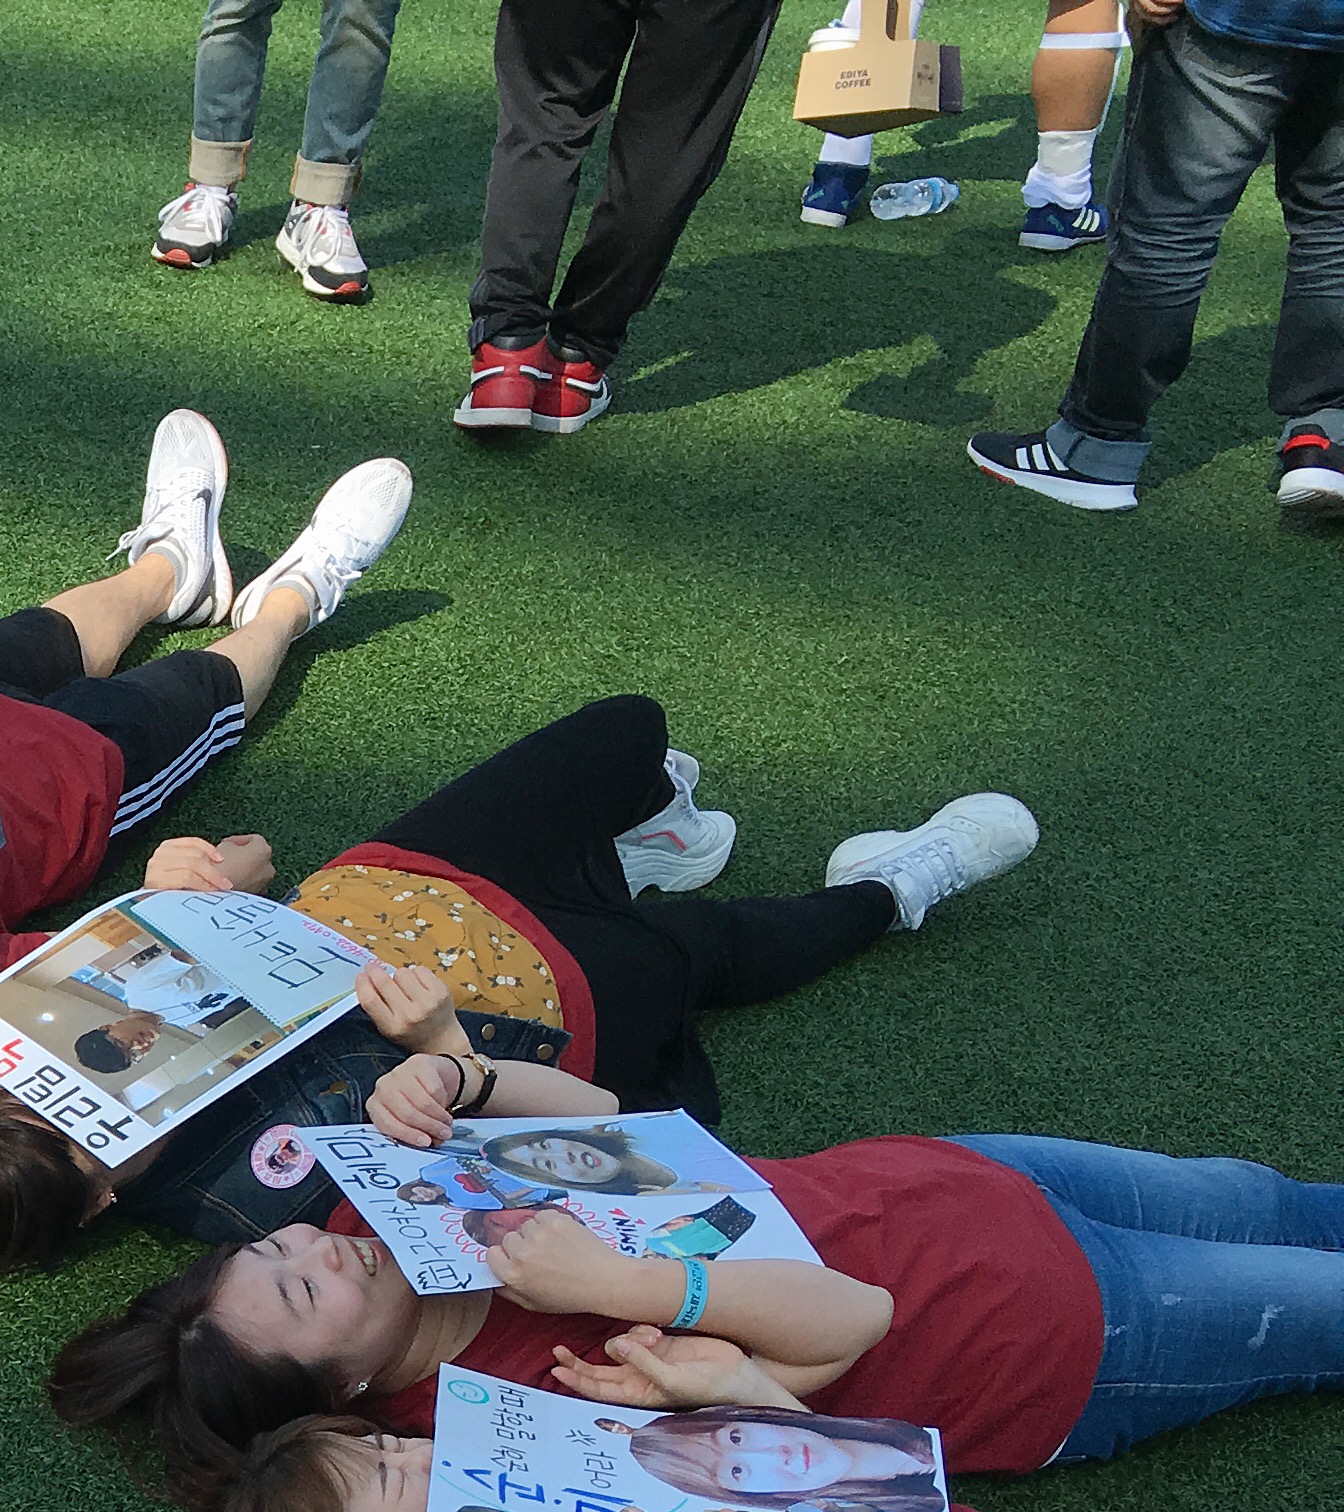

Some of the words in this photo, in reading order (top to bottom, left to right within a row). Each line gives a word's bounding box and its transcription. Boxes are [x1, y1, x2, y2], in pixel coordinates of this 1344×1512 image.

[834, 78, 872, 89] COFFEE
[839, 69, 869, 79] EDIYA
[15, 1064, 142, 1150] 우리팀
[369, 1199, 459, 1285] 피구여신
